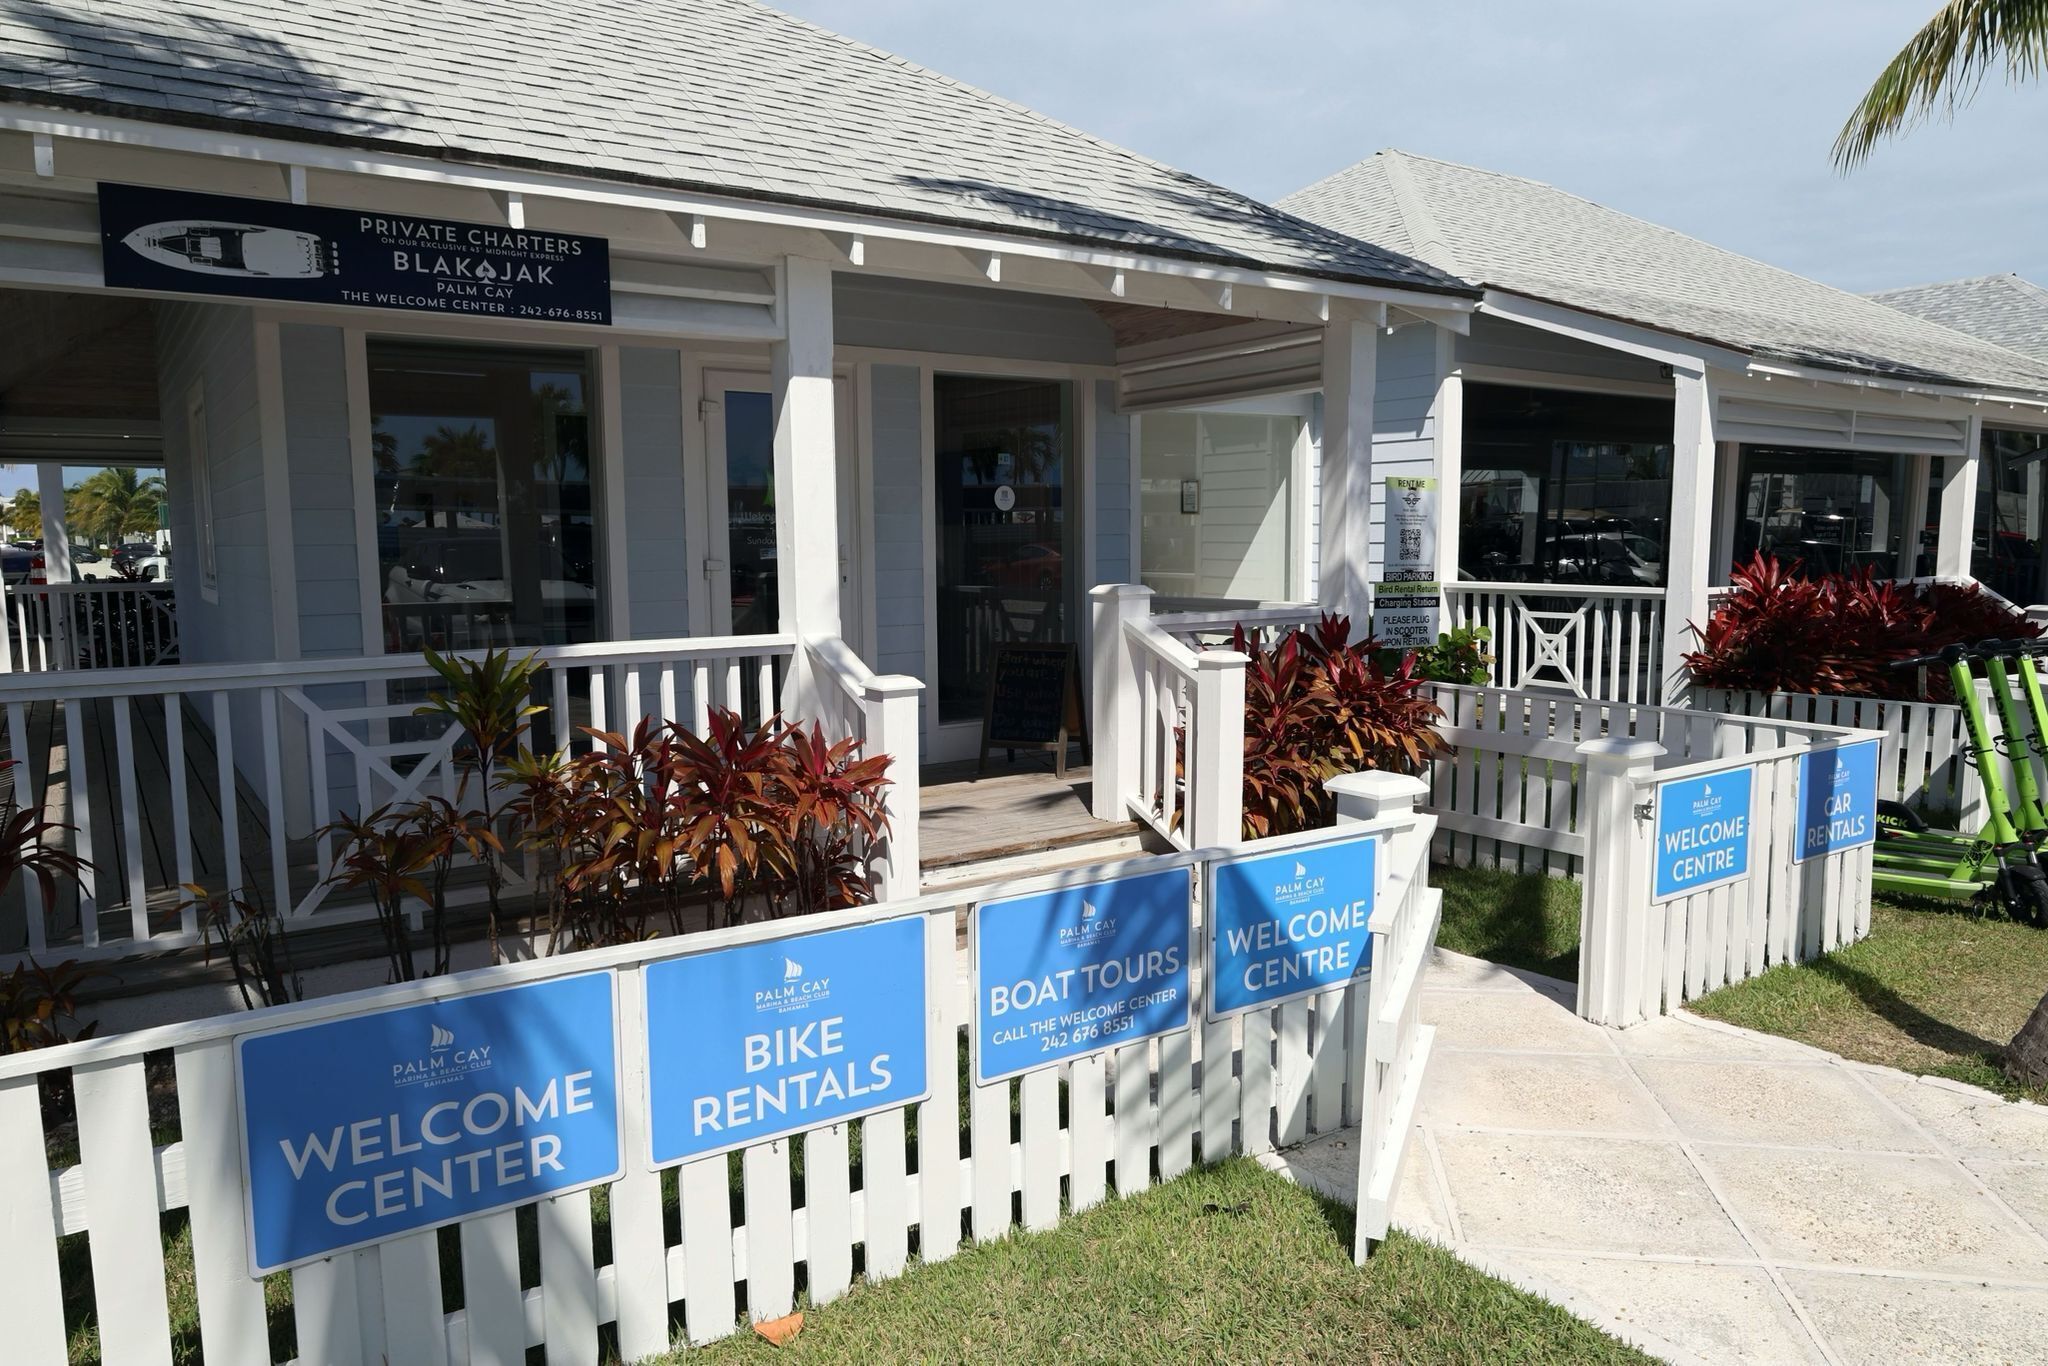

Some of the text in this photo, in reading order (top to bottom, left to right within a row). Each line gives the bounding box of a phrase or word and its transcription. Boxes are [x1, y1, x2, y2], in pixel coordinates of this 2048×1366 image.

[360, 217, 582, 256] PRIVATE CHARTERS
[381, 237, 395, 245] ON
[421, 241, 467, 252] EXCLUSIVE
[485, 248, 527, 258] MIDNIGHT
[530, 252, 565, 262] EXPRESS
[393, 250, 554, 285] BLAK JAK
[437, 282, 513, 299] PALM CAY
[342, 290, 370, 302] THE
[376, 293, 447, 308] WELCOME
[452, 299, 505, 313] CENTER
[520, 305, 603, 321] 242-676-8551
[1398, 479, 1425, 488] RENT ME
[1379, 584, 1438, 593] Bird Rental Return
[1386, 571, 1432, 581] BIRD PARKING
[1379, 597, 1436, 608] Charging Station
[1383, 615, 1430, 624] PLEASE PLUG
[1386, 626, 1428, 635] IN SCOOTER
[1403, 637, 1431, 646] RETURN.
[1824, 793, 1851, 816] CAR
[1807, 815, 1865, 848] RENTALS
[1876, 814, 1908, 828] KICK
[1665, 816, 1745, 855] WELCOME
[1672, 847, 1735, 882] CENTRE
[1275, 876, 1324, 896] PALM CAY
[1060, 919, 1116, 939] PALM CAY
[1227, 900, 1365, 957] WELCOME
[1244, 941, 1350, 991] CENTRE
[755, 976, 830, 1004] PALM CAY
[813, 989, 830, 998] CLUB
[990, 946, 1180, 1017] BOAT TOURS
[778, 1003, 809, 1013] BAHAMAS
[992, 988, 1177, 1045] CALL THE WELCOME CENTER
[745, 1016, 844, 1073] BIKE
[1040, 1014, 1135, 1052] 242 676 8551
[393, 1046, 490, 1077] PALM CAY
[394, 1073, 428, 1085] MARINA
[440, 1066, 468, 1076] BEACH
[470, 1059, 492, 1069] CLUB
[424, 1075, 465, 1088] BAHAMAS
[693, 1054, 893, 1136] RENTALS
[278, 1070, 594, 1180] WELCOME
[325, 1134, 566, 1226] CENTER
